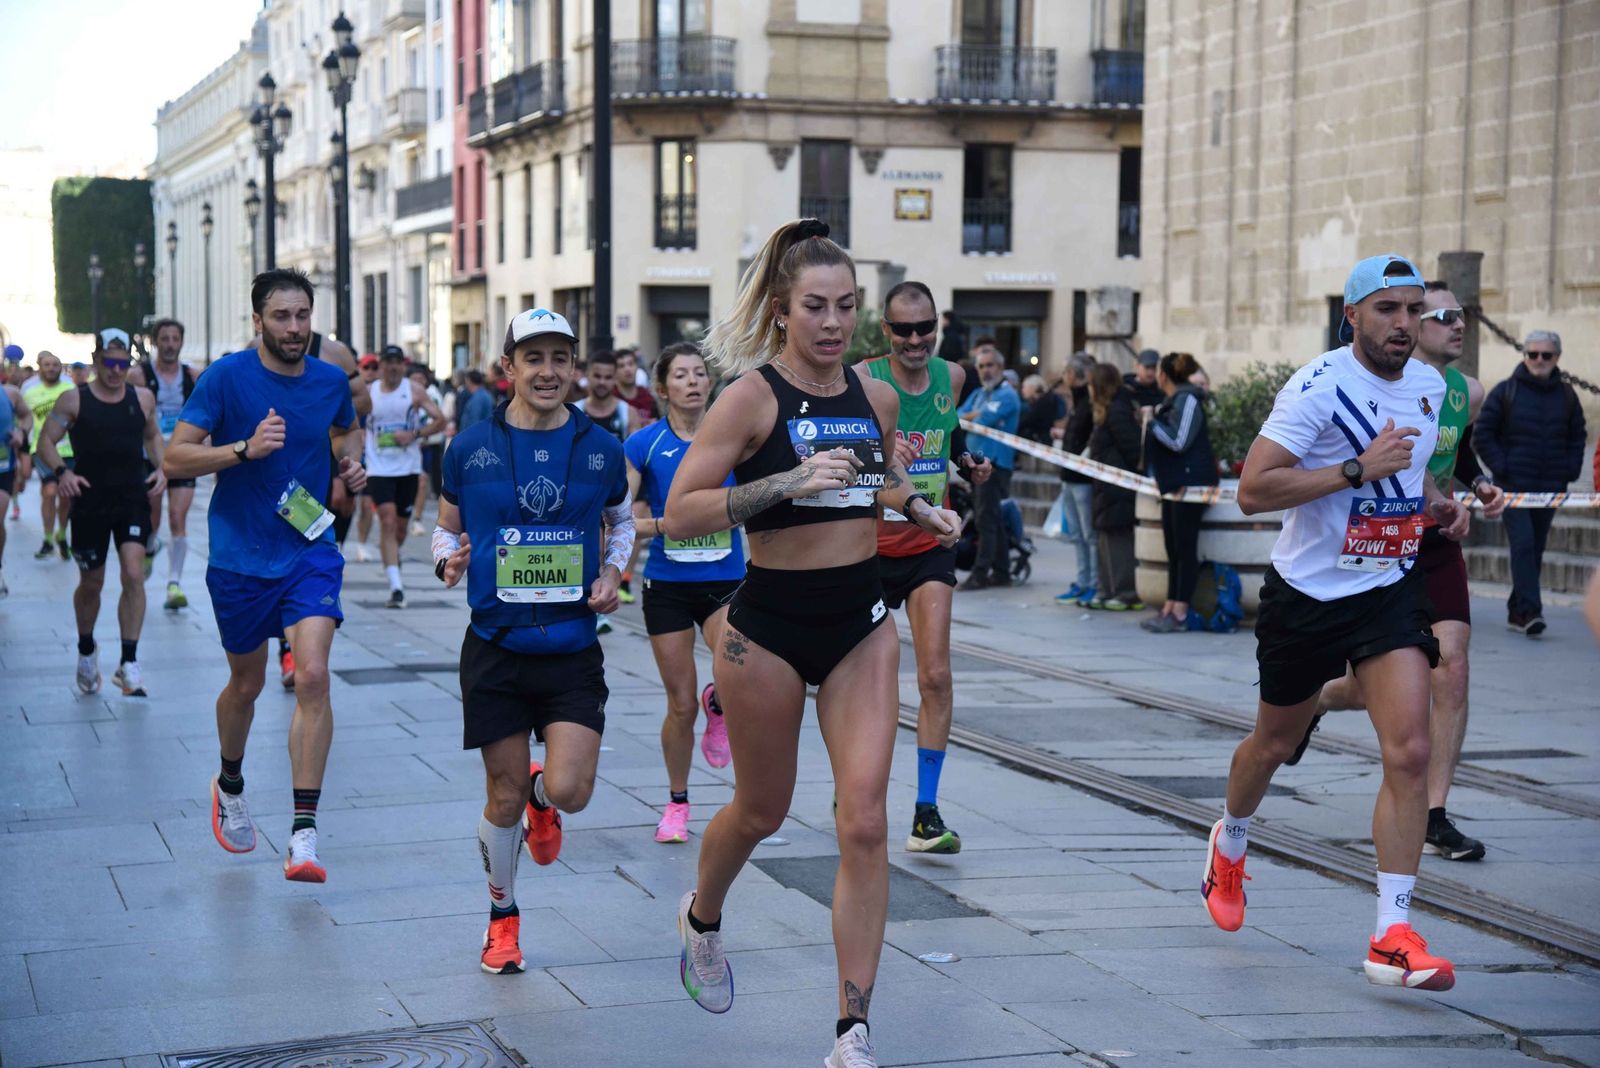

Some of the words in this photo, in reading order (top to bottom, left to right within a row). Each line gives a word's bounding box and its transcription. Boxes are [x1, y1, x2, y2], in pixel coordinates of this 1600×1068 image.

[821, 423, 869, 434] ZURICH
[908, 462, 940, 472] ZURICH
[1382, 501, 1419, 513] ZURICH
[1381, 525, 1399, 536] 1458
[526, 531, 573, 542] ZURICH
[1347, 538, 1387, 554] YOWI
[1400, 538, 1420, 555] ISA
[527, 554, 553, 564] 2614
[512, 569, 567, 584] RONAN
